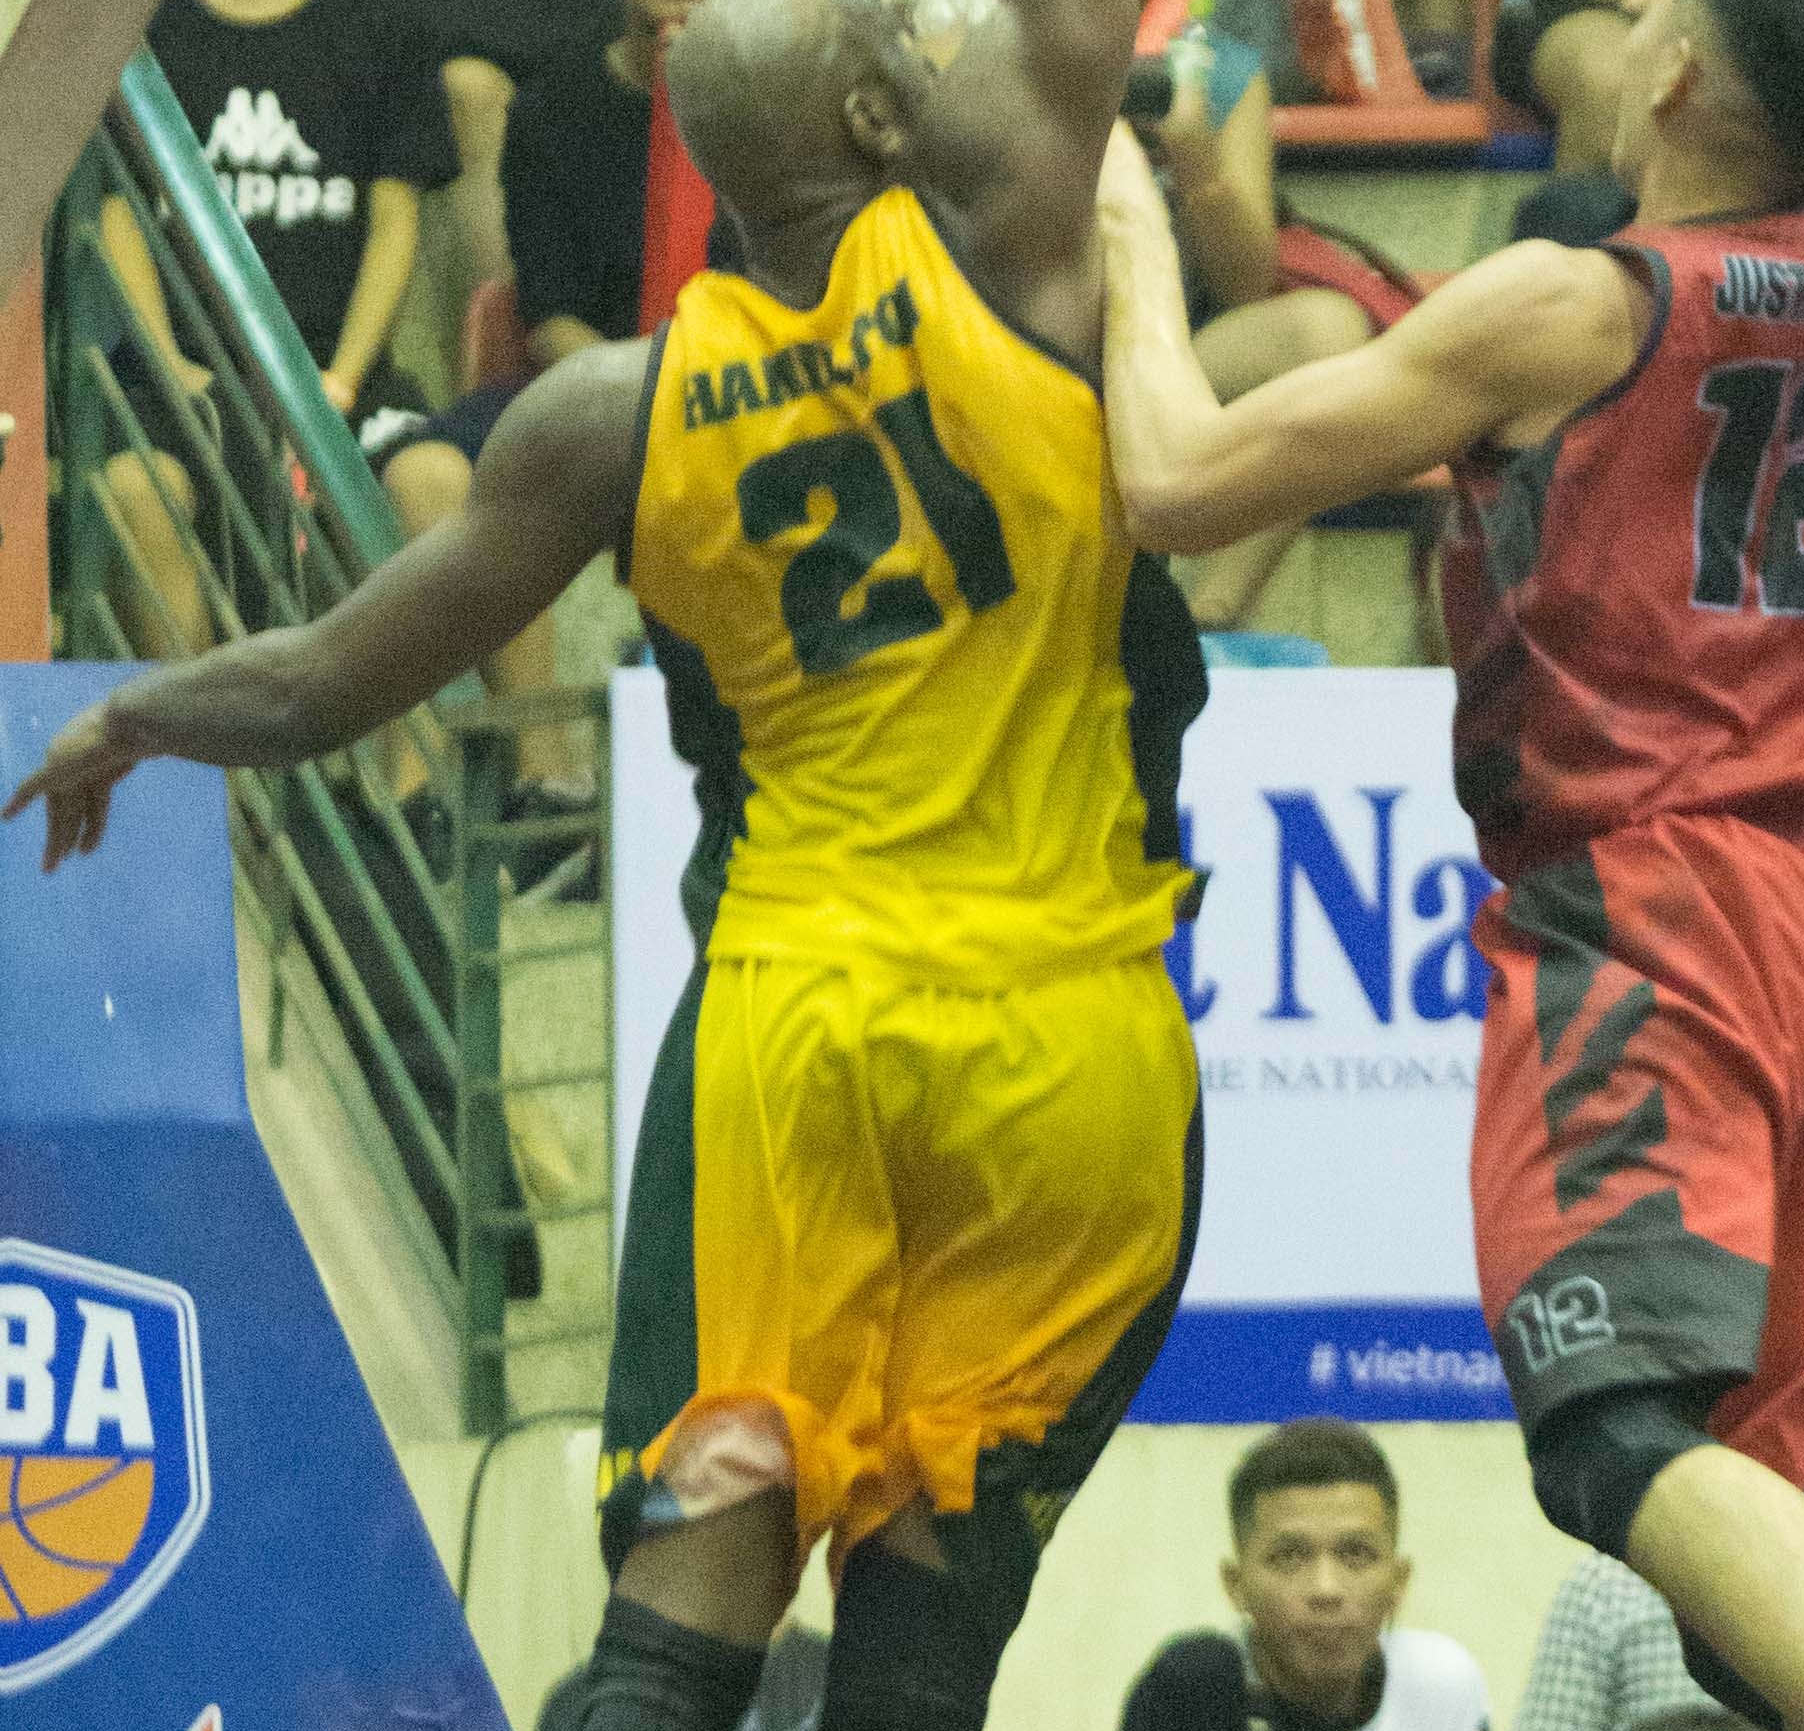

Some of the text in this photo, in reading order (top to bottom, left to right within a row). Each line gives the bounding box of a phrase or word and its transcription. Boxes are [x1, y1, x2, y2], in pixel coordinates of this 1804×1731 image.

[737, 384, 1017, 676] 21
[1258, 785, 1488, 1028] Na
[1257, 1056, 1477, 1093] NATIONA
[1346, 1337, 1502, 1390] vietna
[1505, 1274, 1617, 1373] 12
